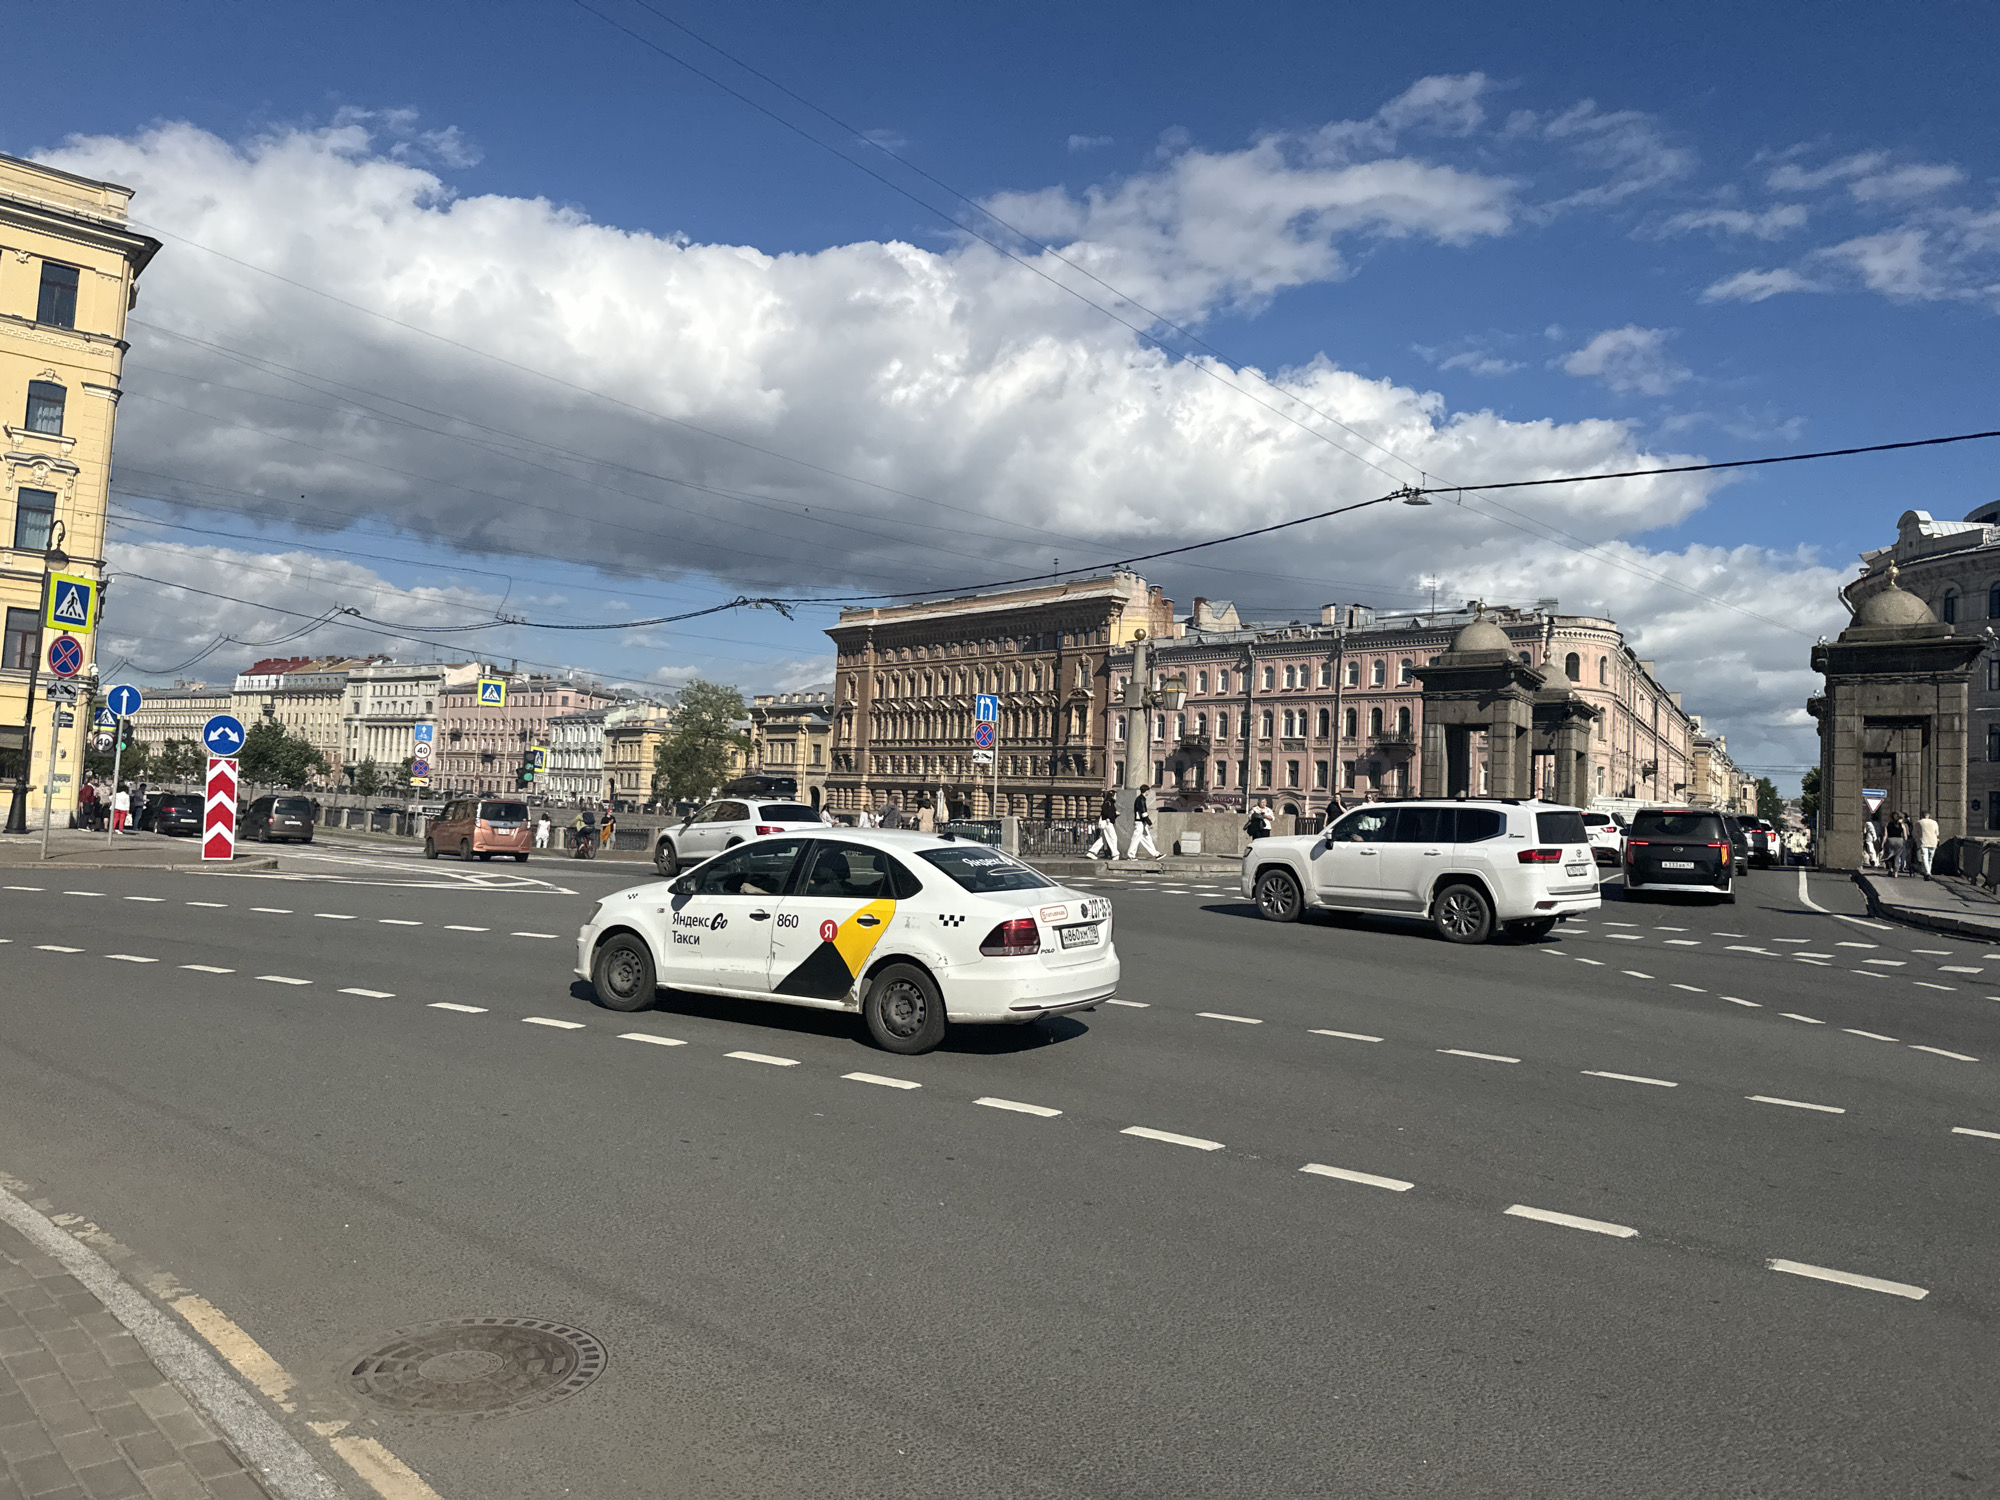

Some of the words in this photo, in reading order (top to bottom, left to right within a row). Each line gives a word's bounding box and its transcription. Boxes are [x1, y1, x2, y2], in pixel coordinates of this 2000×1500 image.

[96, 738, 110, 746] 40
[672, 911, 710, 928] Яндекс
[710, 912, 728, 931] Go
[776, 913, 799, 928] 860
[672, 930, 700, 946] Такси
[824, 923, 833, 939] Я
